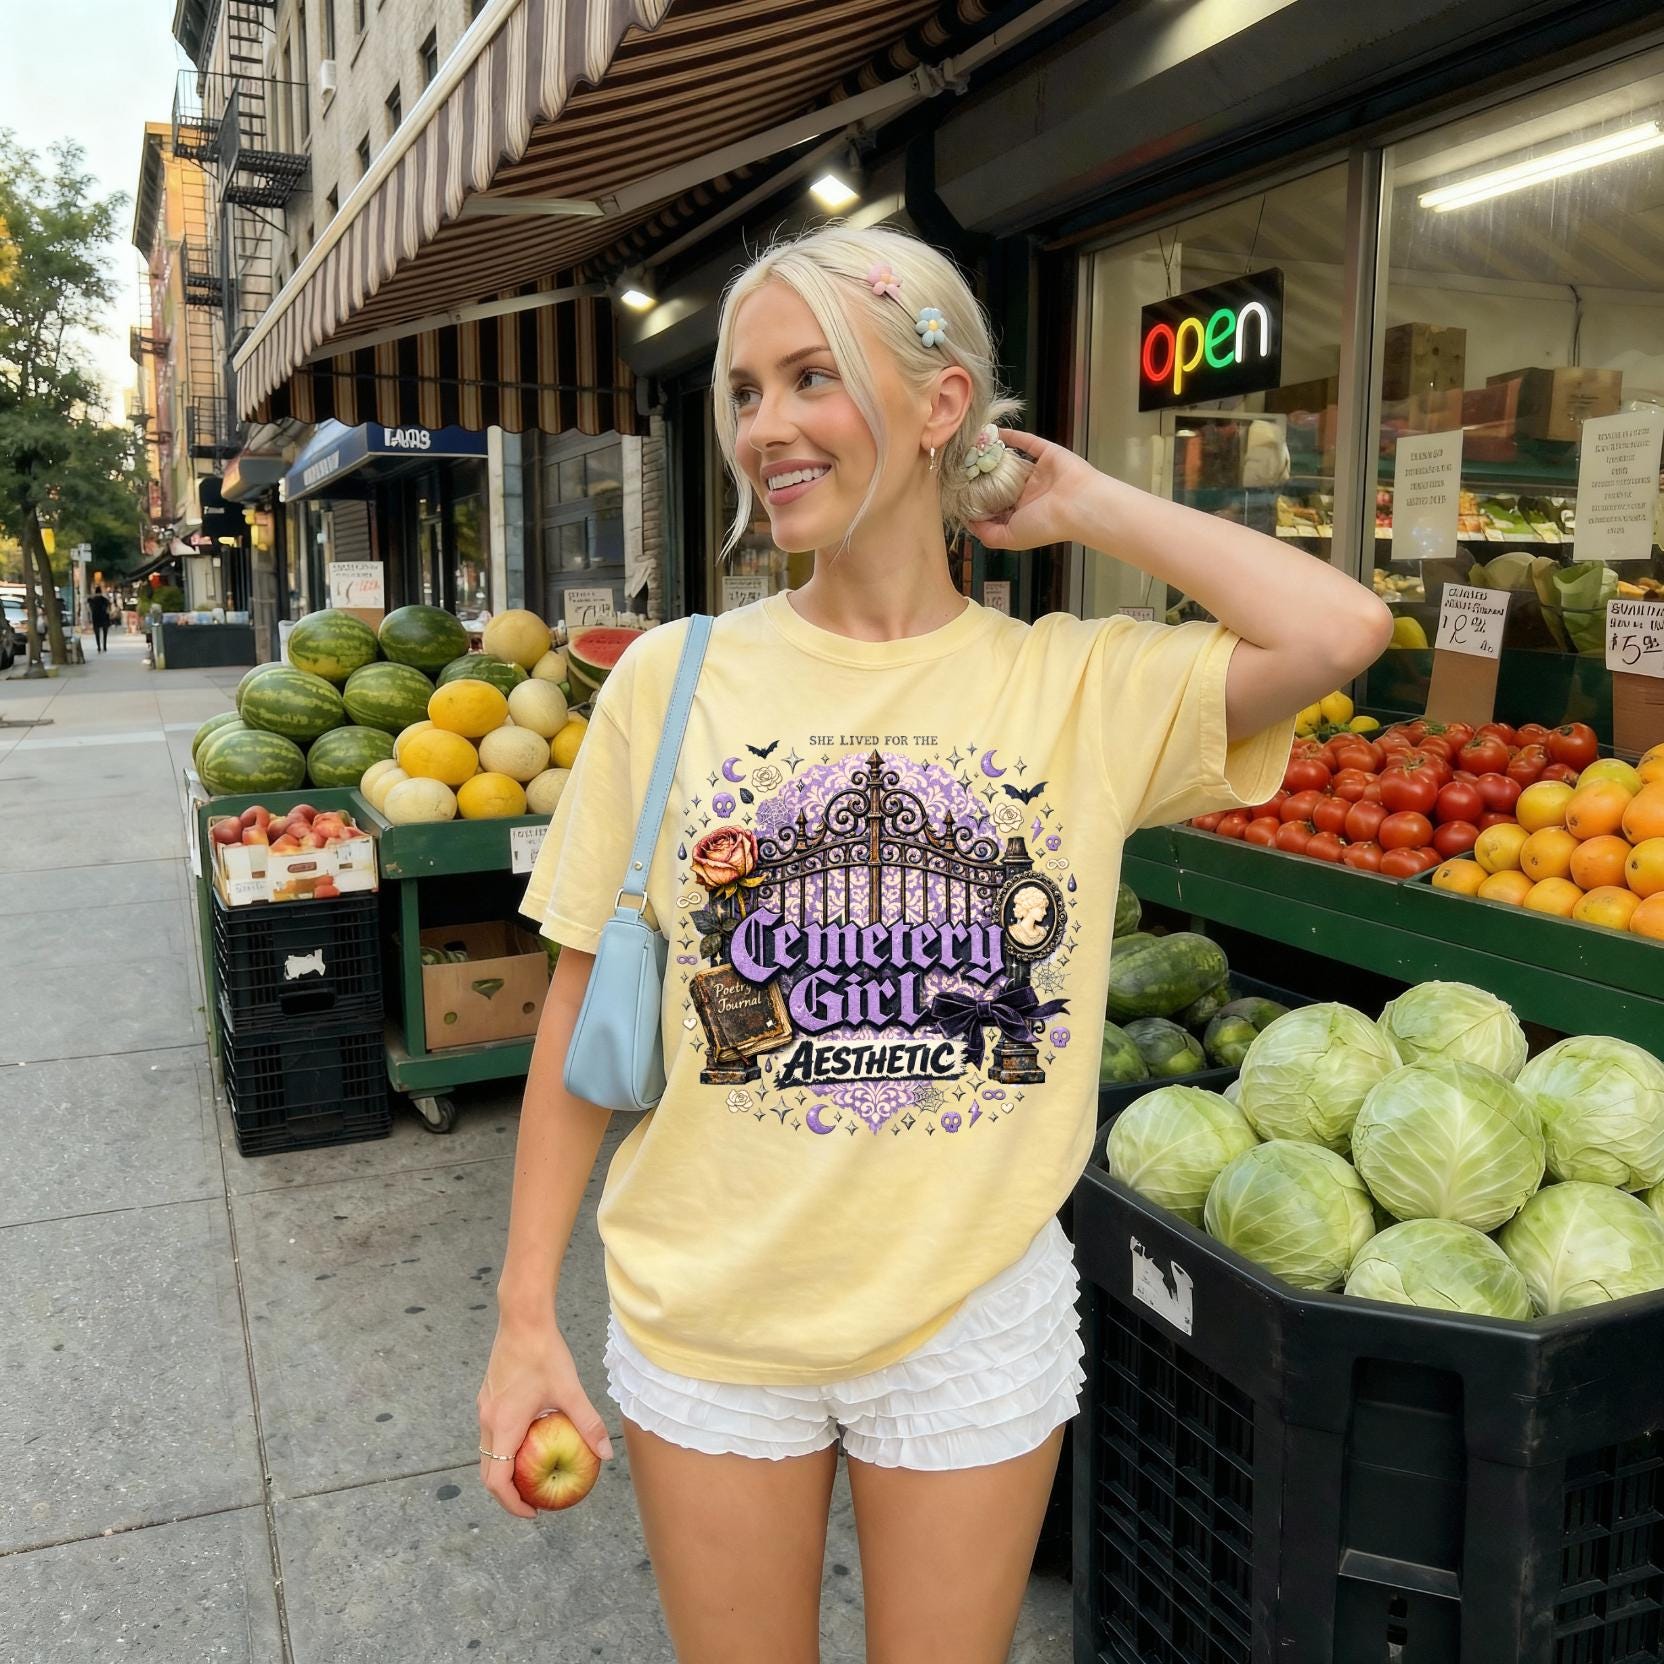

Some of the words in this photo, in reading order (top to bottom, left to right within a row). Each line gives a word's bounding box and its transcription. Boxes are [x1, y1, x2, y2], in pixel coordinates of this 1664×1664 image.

[1142, 301, 1269, 396] open
[809, 735, 835, 746] SHE
[839, 735, 880, 746] LIVED
[884, 735, 909, 746] FOR
[913, 735, 939, 746] THE
[729, 905, 1006, 986] Cemetery
[713, 982, 752, 998] Poetry
[717, 991, 762, 1014] Journal
[787, 967, 930, 1034] Girl
[778, 1040, 957, 1084] AESTHETIC
